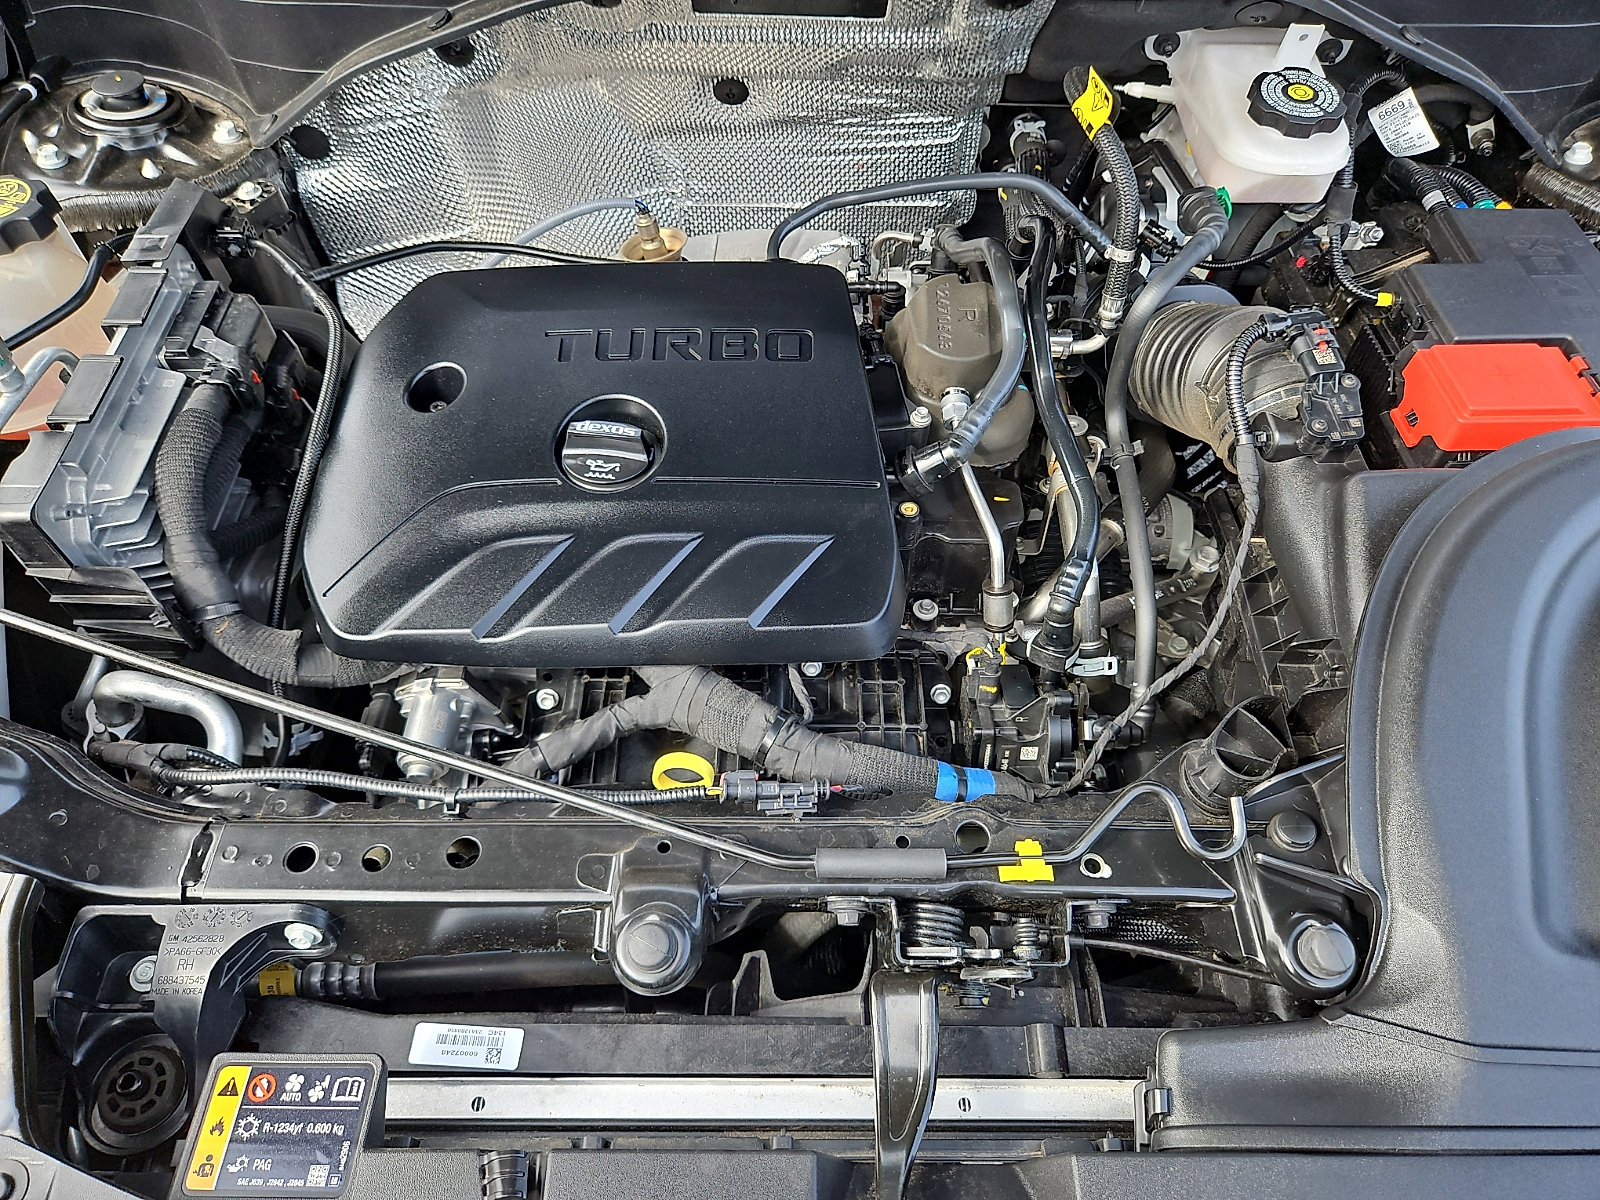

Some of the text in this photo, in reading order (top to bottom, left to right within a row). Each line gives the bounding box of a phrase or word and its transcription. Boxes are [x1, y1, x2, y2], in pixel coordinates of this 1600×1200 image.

[1377, 100, 1406, 121] 6669
[544, 327, 815, 362] TURBO
[575, 419, 637, 437] dexos
[167, 934, 180, 944] GM
[177, 958, 195, 971] RH
[151, 987, 203, 995] MADE IN KOREA
[279, 1092, 302, 1102] AUTO
[262, 1122, 345, 1136] R-1234yf 0.600 kg
[252, 1158, 272, 1171] PAG
[236, 1177, 250, 1186] SAE
